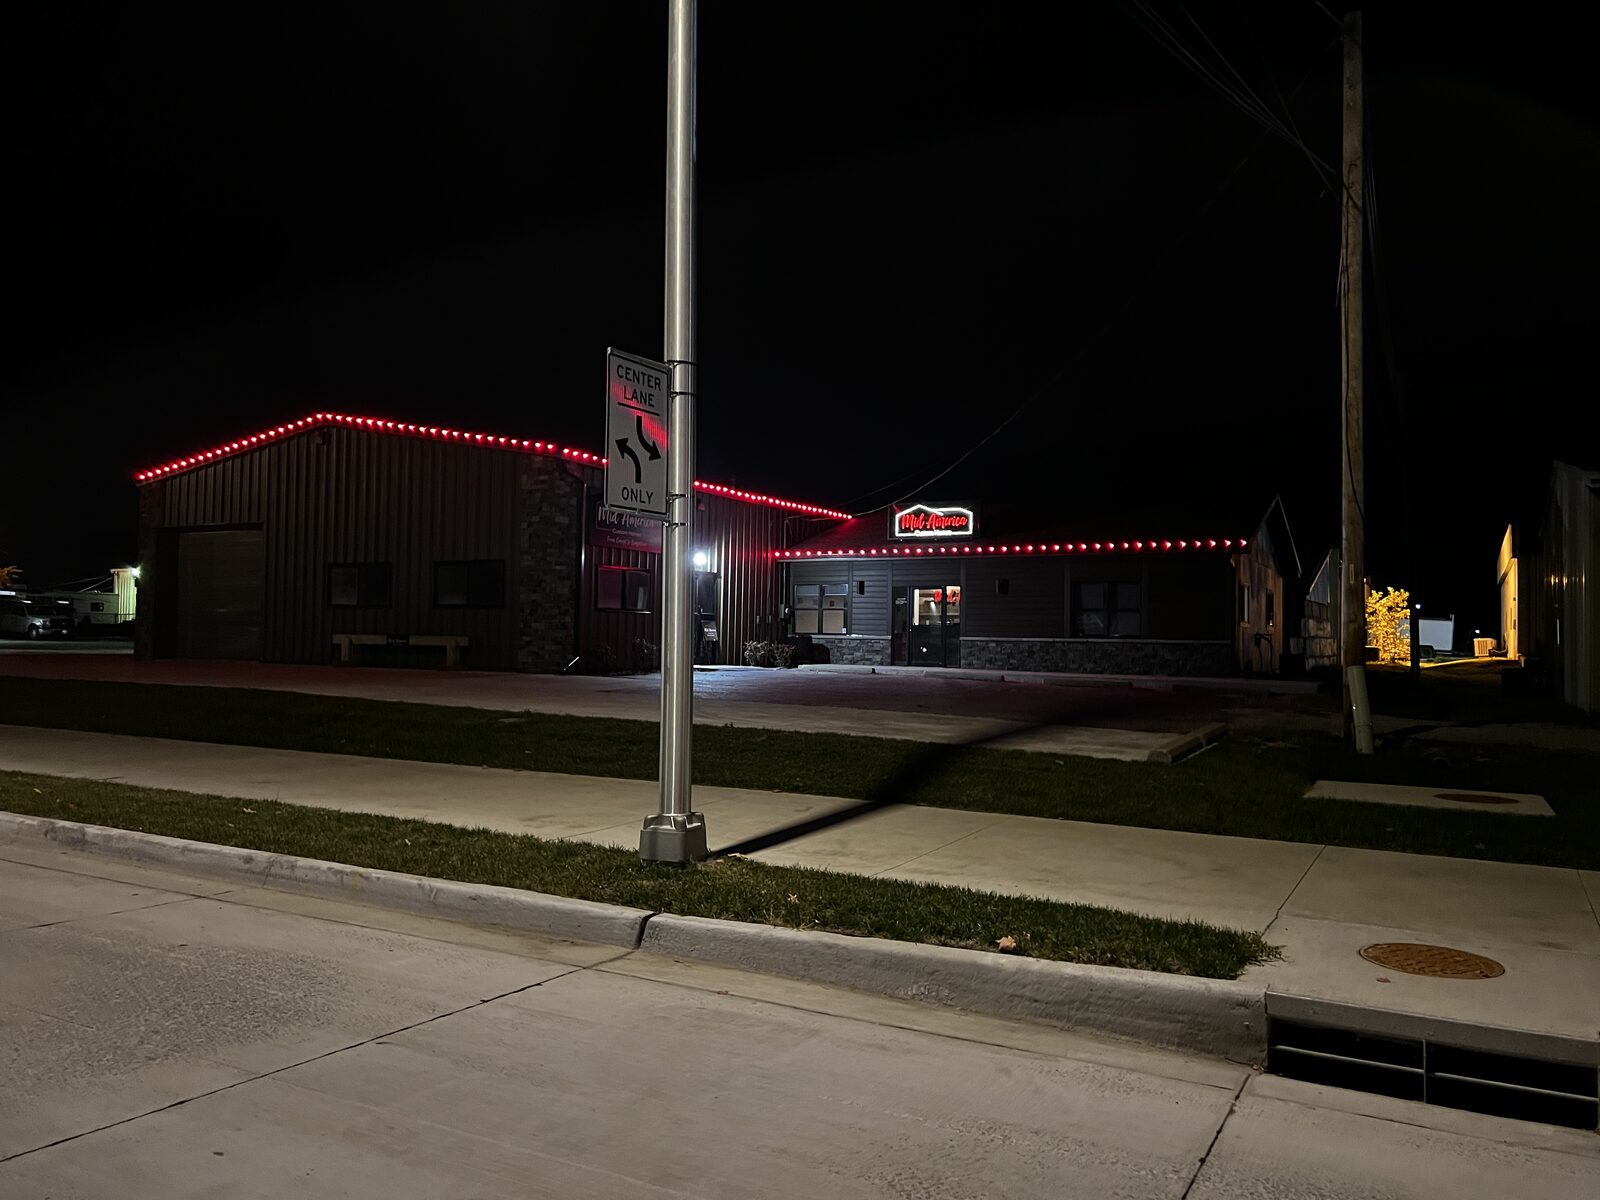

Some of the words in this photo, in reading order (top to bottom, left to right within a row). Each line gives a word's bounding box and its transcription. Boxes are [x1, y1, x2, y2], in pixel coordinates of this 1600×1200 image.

[616, 364, 662, 391] CENTER
[623, 385, 655, 408] LANE
[621, 486, 654, 505] ONLY
